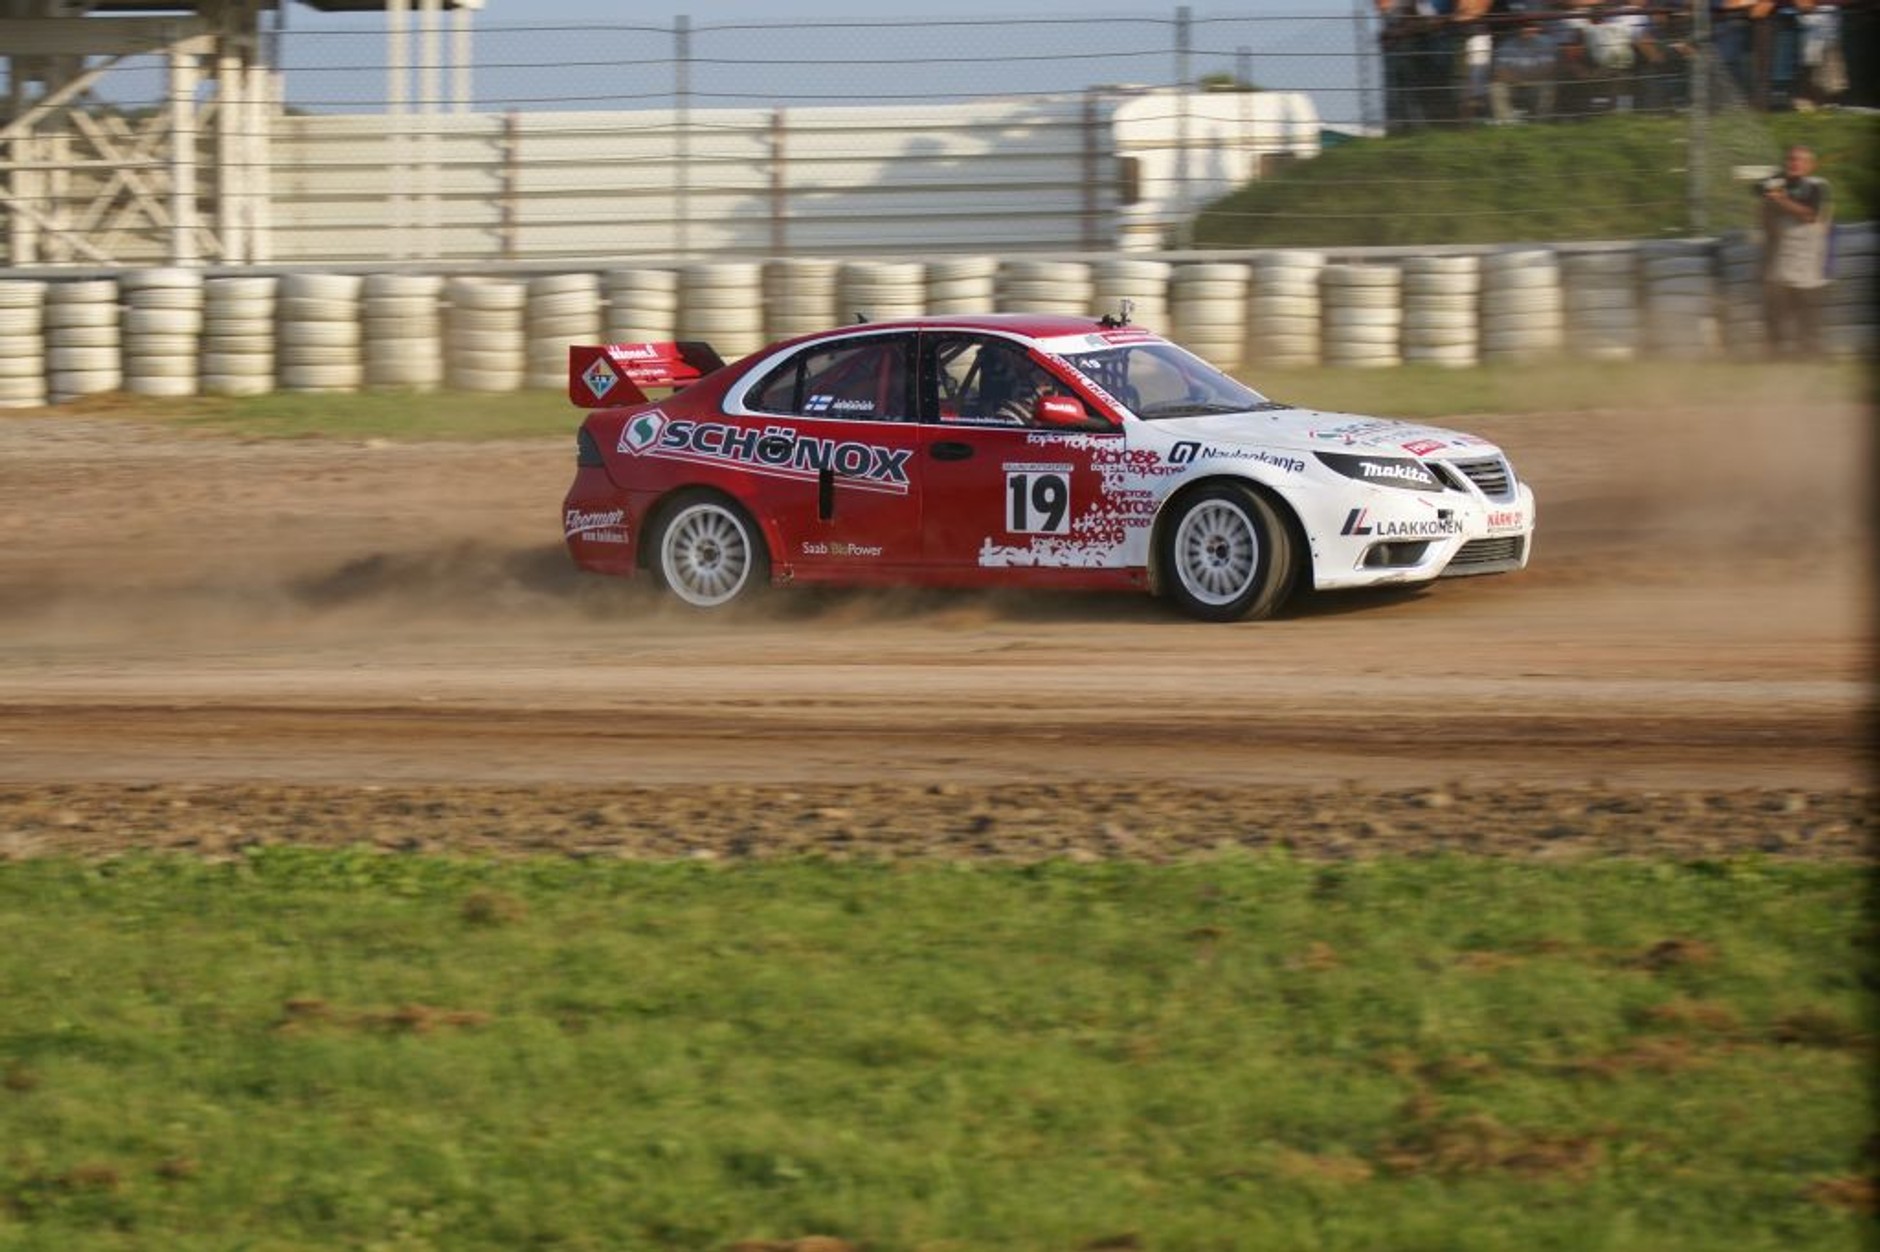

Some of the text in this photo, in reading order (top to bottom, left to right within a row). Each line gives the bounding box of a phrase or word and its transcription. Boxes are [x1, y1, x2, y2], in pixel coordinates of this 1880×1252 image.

[662, 421, 914, 484] SCHÖNOX
[1009, 474, 1068, 532] 19
[802, 542, 828, 554] Saab
